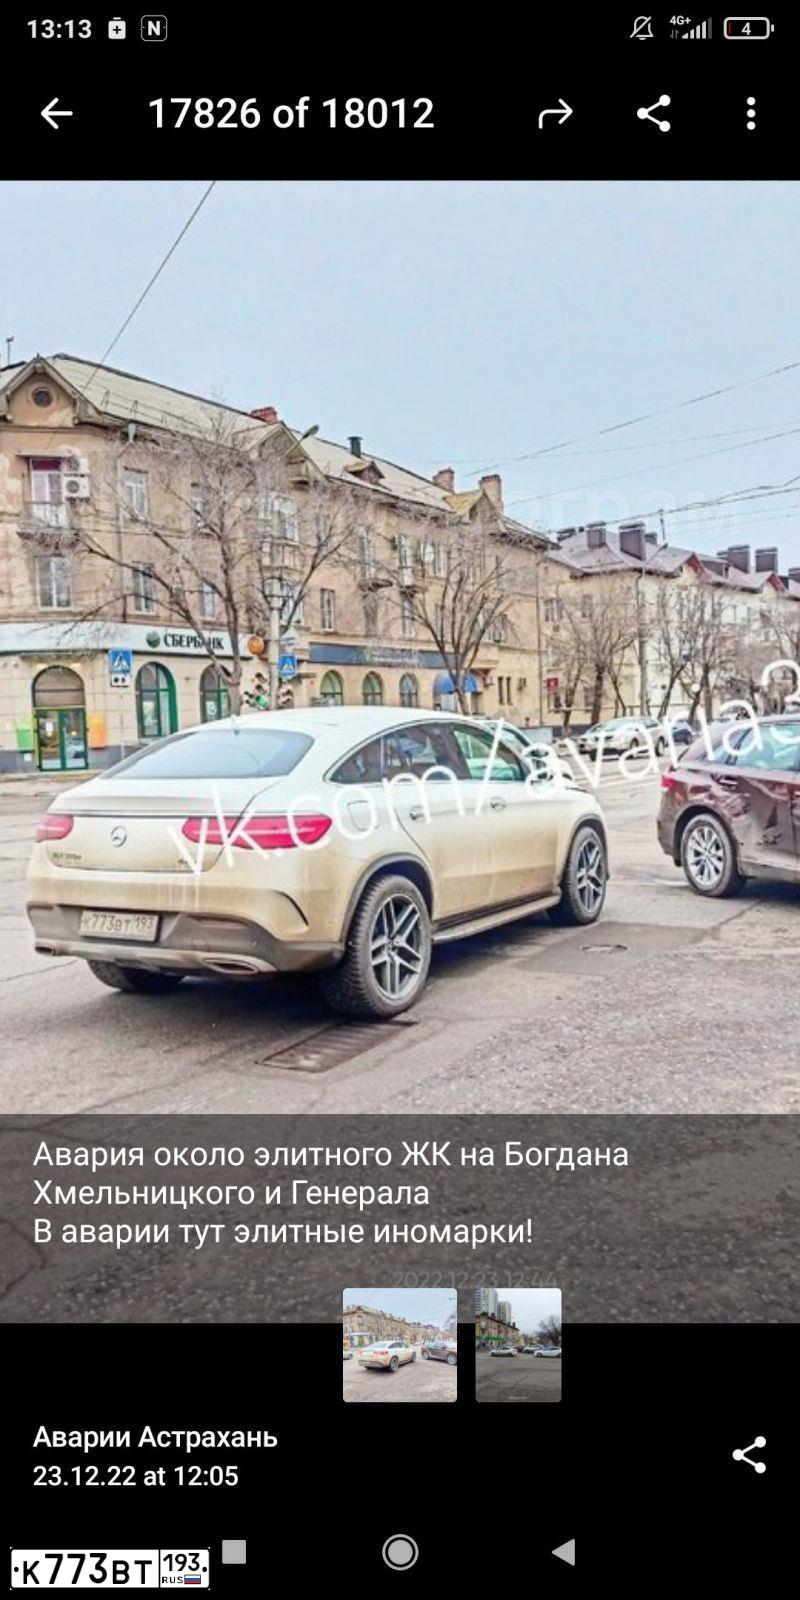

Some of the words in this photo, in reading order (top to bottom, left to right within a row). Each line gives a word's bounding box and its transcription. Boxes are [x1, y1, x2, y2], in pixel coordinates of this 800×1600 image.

[27, 19, 92, 39] 13:13
[669, 15, 692, 25] 4G+
[741, 22, 752, 36] 4
[149, 97, 261, 129] 17826
[273, 95, 310, 129] of
[322, 97, 435, 129] 18012
[32, 1425, 131, 1452] Аварии
[137, 1425, 278, 1454] Астрахань
[33, 1465, 137, 1487] 23.12.22
[143, 1467, 166, 1487] at
[174, 1465, 239, 1487] 12:05
